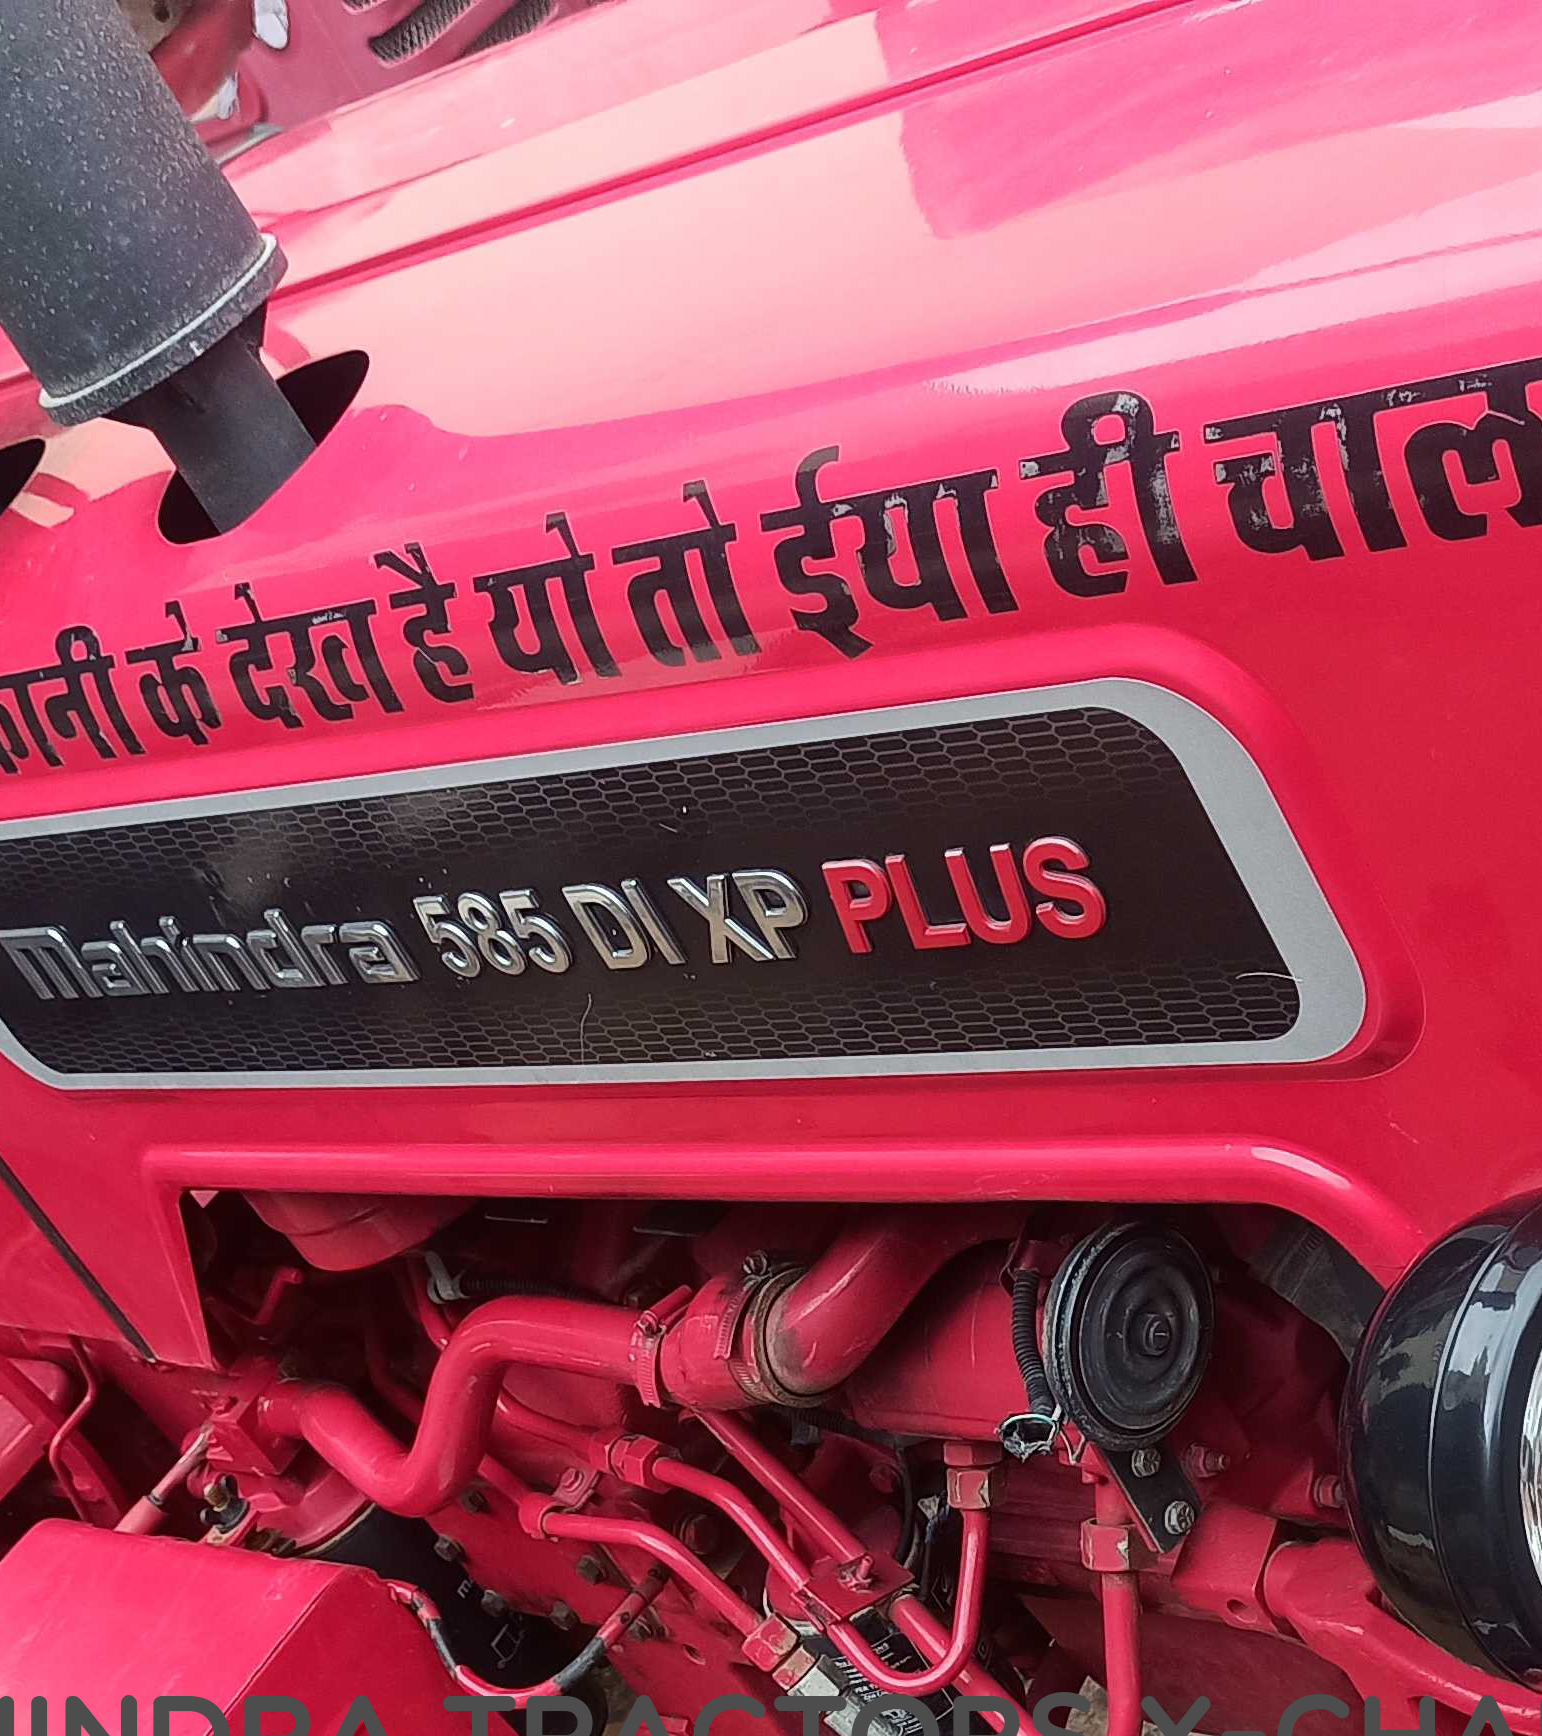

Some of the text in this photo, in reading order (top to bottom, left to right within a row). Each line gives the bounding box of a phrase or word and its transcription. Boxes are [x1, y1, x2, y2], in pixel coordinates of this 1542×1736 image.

[126, 600, 221, 746] के
[215, 582, 404, 729] देख
[374, 542, 474, 703] है
[472, 510, 622, 685] यो
[611, 480, 762, 667] तो
[1018, 391, 1198, 599] ही
[413, 888, 574, 977] 585
[562, 878, 686, 970] DI
[667, 868, 808, 965] XP
[821, 835, 1107, 954] PLUS
